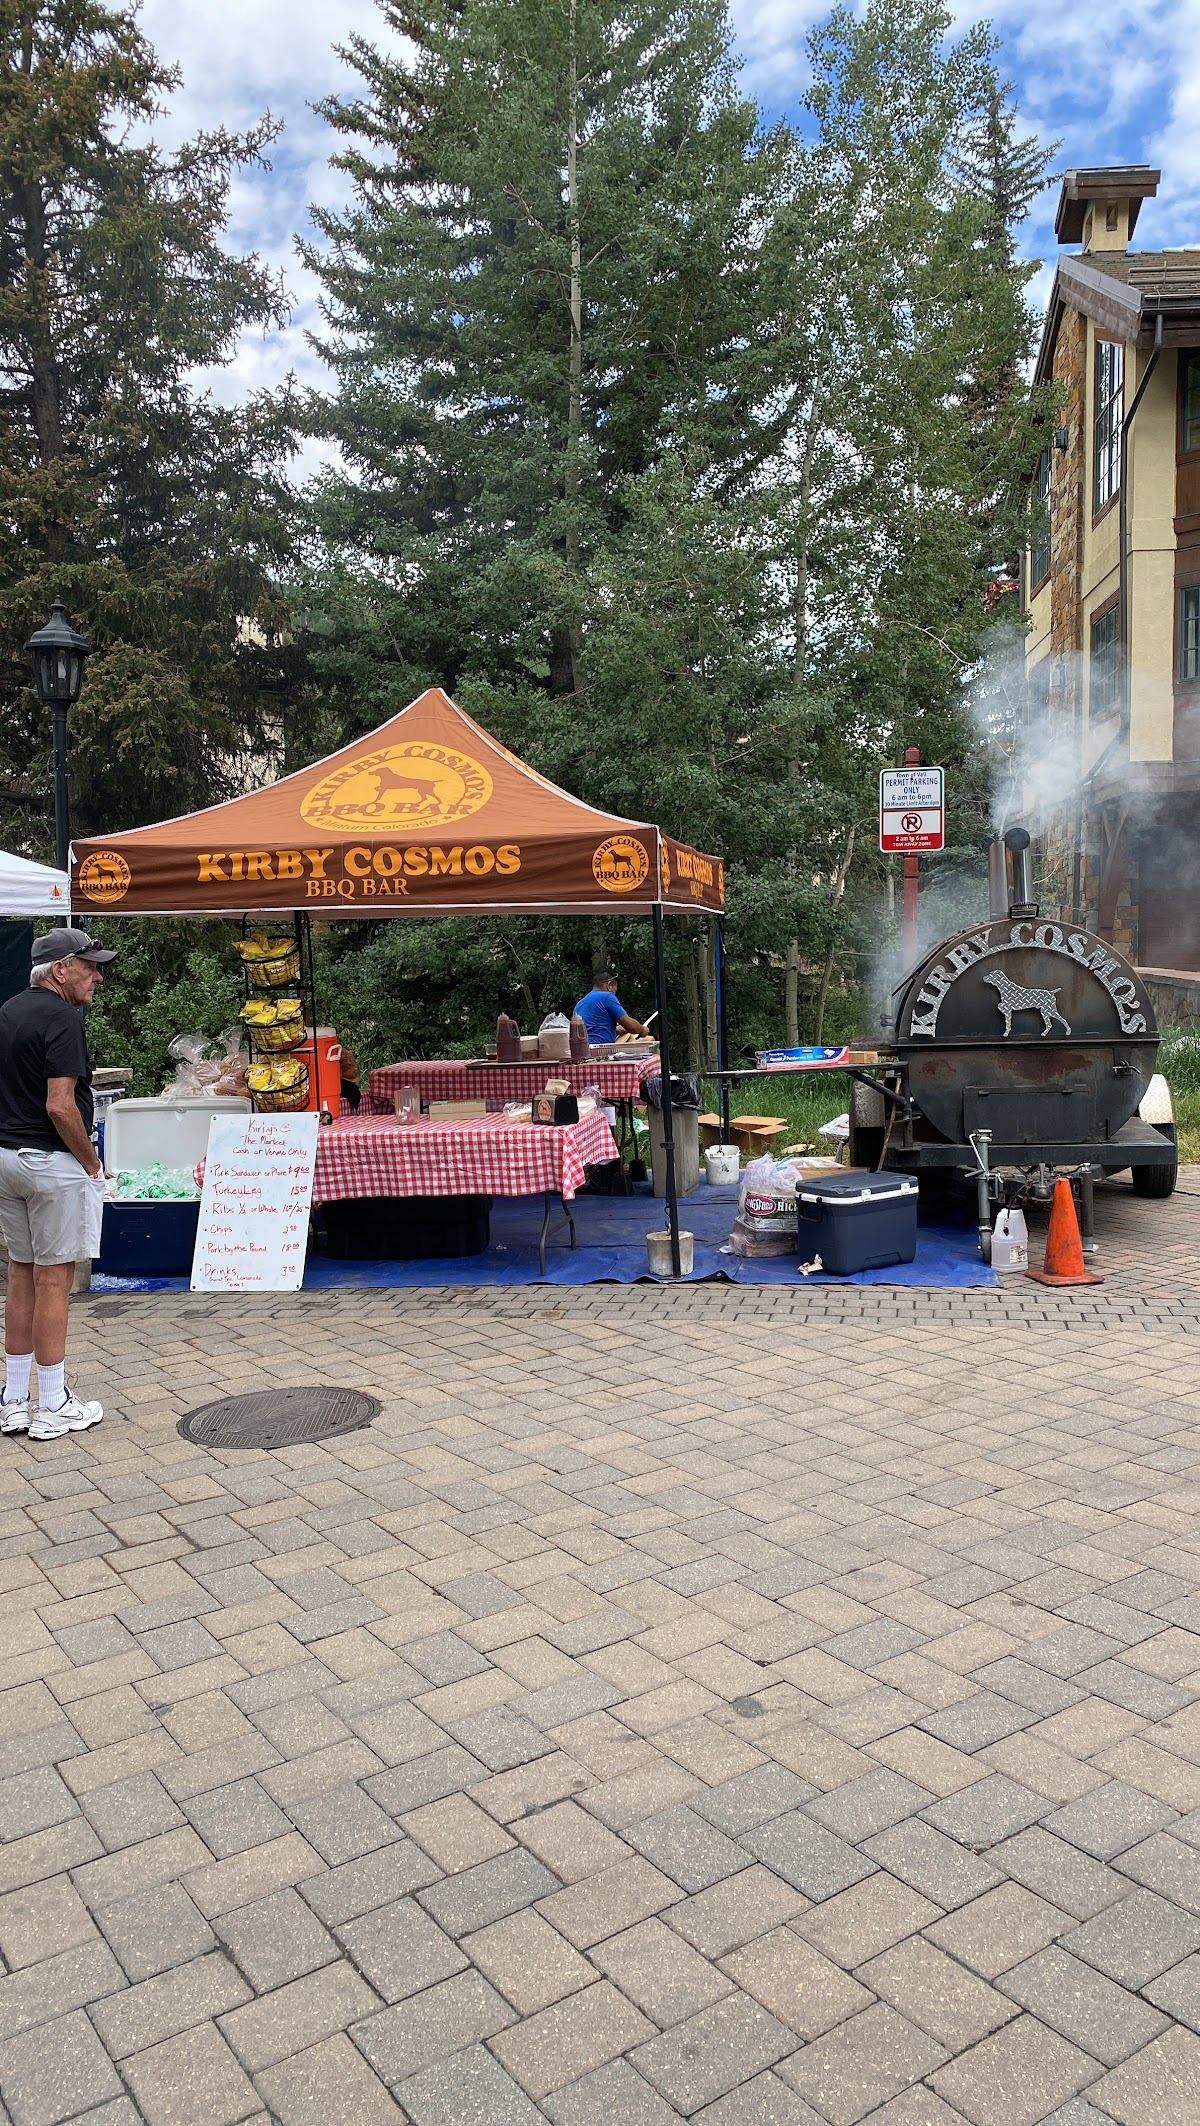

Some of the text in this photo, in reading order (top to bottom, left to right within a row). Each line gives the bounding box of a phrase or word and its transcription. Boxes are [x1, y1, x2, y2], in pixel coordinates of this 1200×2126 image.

[311, 750, 391, 803] KIRBY
[885, 777, 939, 787] PERMIT PARKING
[903, 786, 920, 794] ONLY
[917, 793, 932, 801] 6pm
[302, 801, 474, 817] BBQ BAR
[372, 818, 439, 831] Colorado
[594, 840, 614, 869] KIRBY
[81, 854, 99, 882] KIRBY
[196, 844, 522, 882] KIRBY COSMOS
[596, 870, 646, 881] BBQ BAR
[81, 882, 128, 893] BBQ BAR
[304, 877, 410, 900] BBQ BAR
[909, 928, 993, 1038] KIRBY
[241, 1135, 258, 1145] The
[232, 1146, 249, 1155] Cash
[264, 1148, 287, 1156] Venmo
[287, 1147, 308, 1158] Only
[211, 1164, 230, 1177] Pork
[230, 1165, 263, 1177] Sandwich
[212, 1202, 235, 1215] Ribs
[258, 1204, 279, 1214] Whole
[209, 1223, 233, 1236] Chips
[207, 1242, 224, 1254] Pork
[249, 1242, 267, 1253] Pound
[204, 1262, 237, 1278] Drinks
